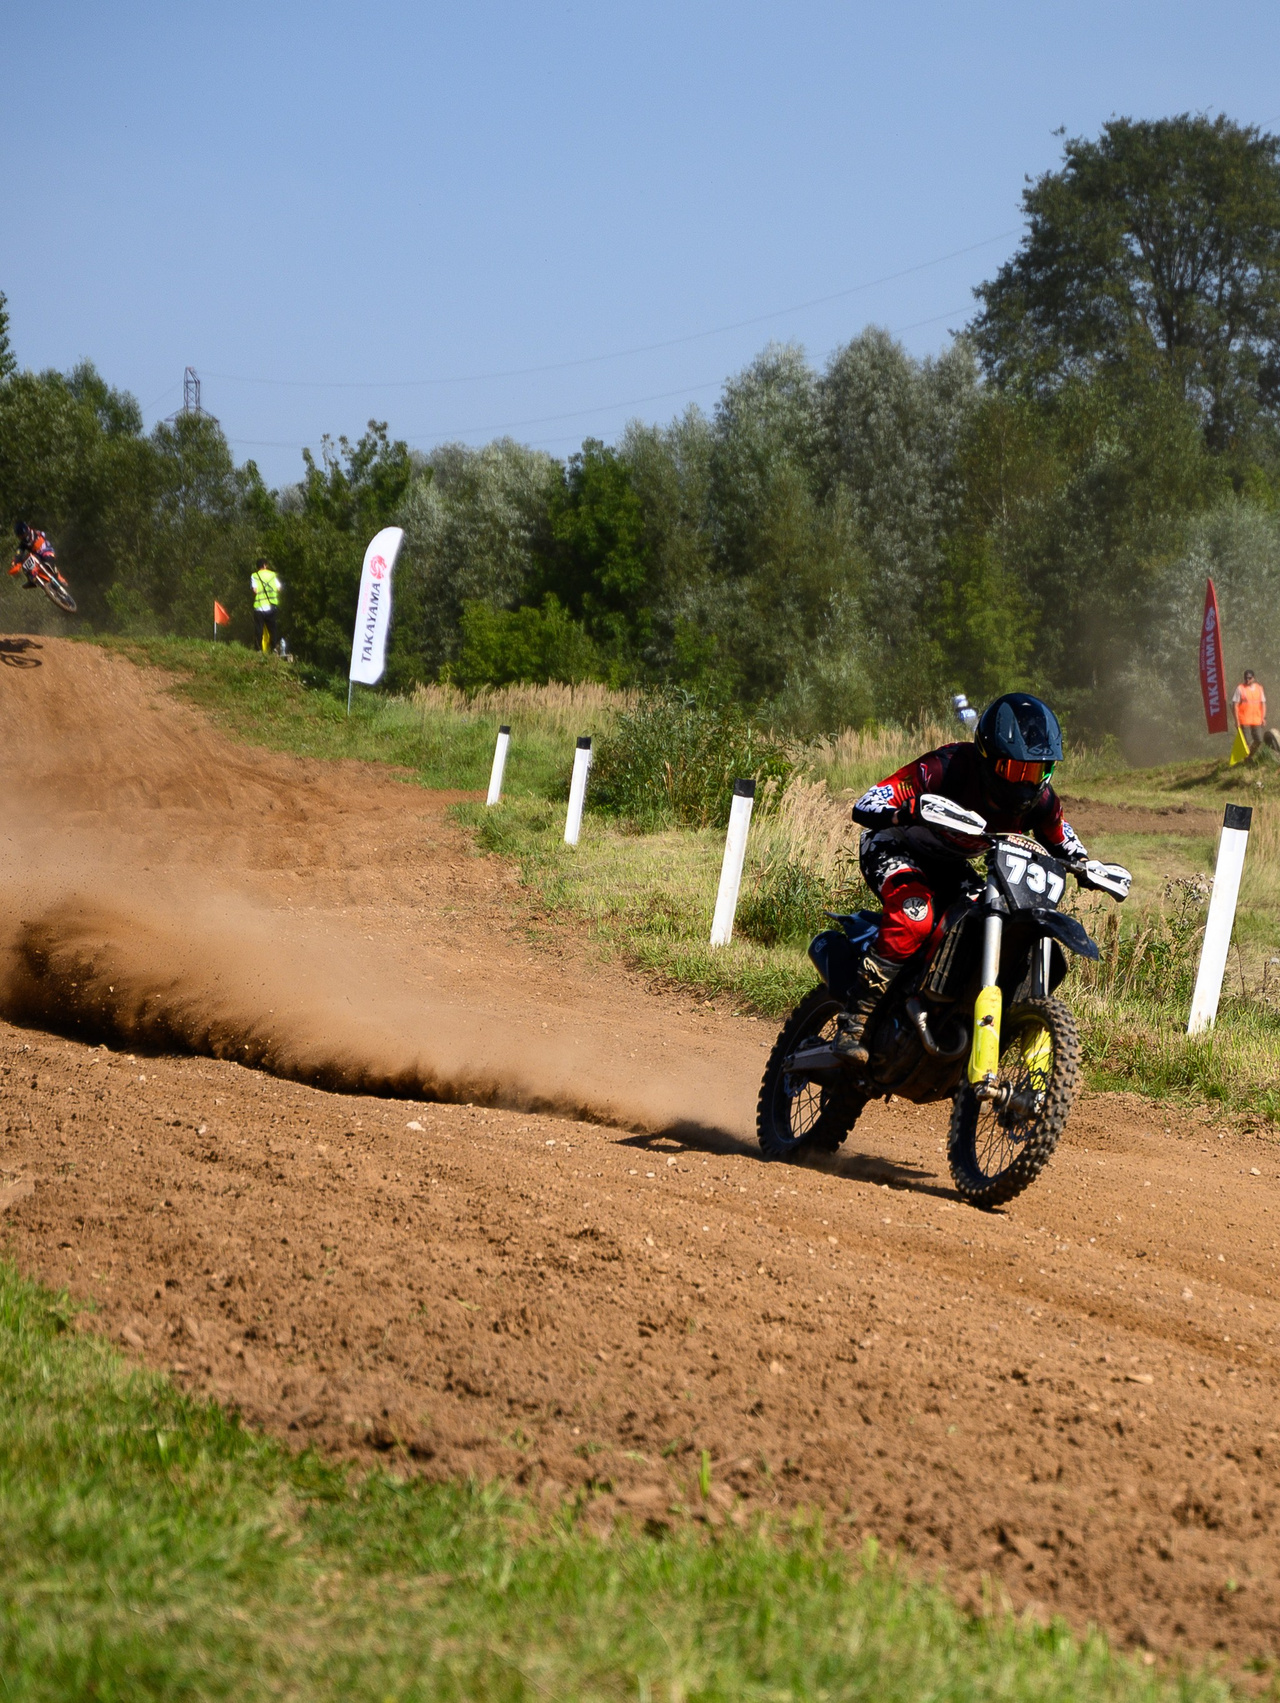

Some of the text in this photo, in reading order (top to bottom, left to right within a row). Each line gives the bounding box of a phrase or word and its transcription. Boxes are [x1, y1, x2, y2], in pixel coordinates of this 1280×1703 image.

[361, 582, 381, 663] TAKAYAMA
[1205, 632, 1220, 716] TAKAYAMA
[1006, 854, 1064, 903] 737
